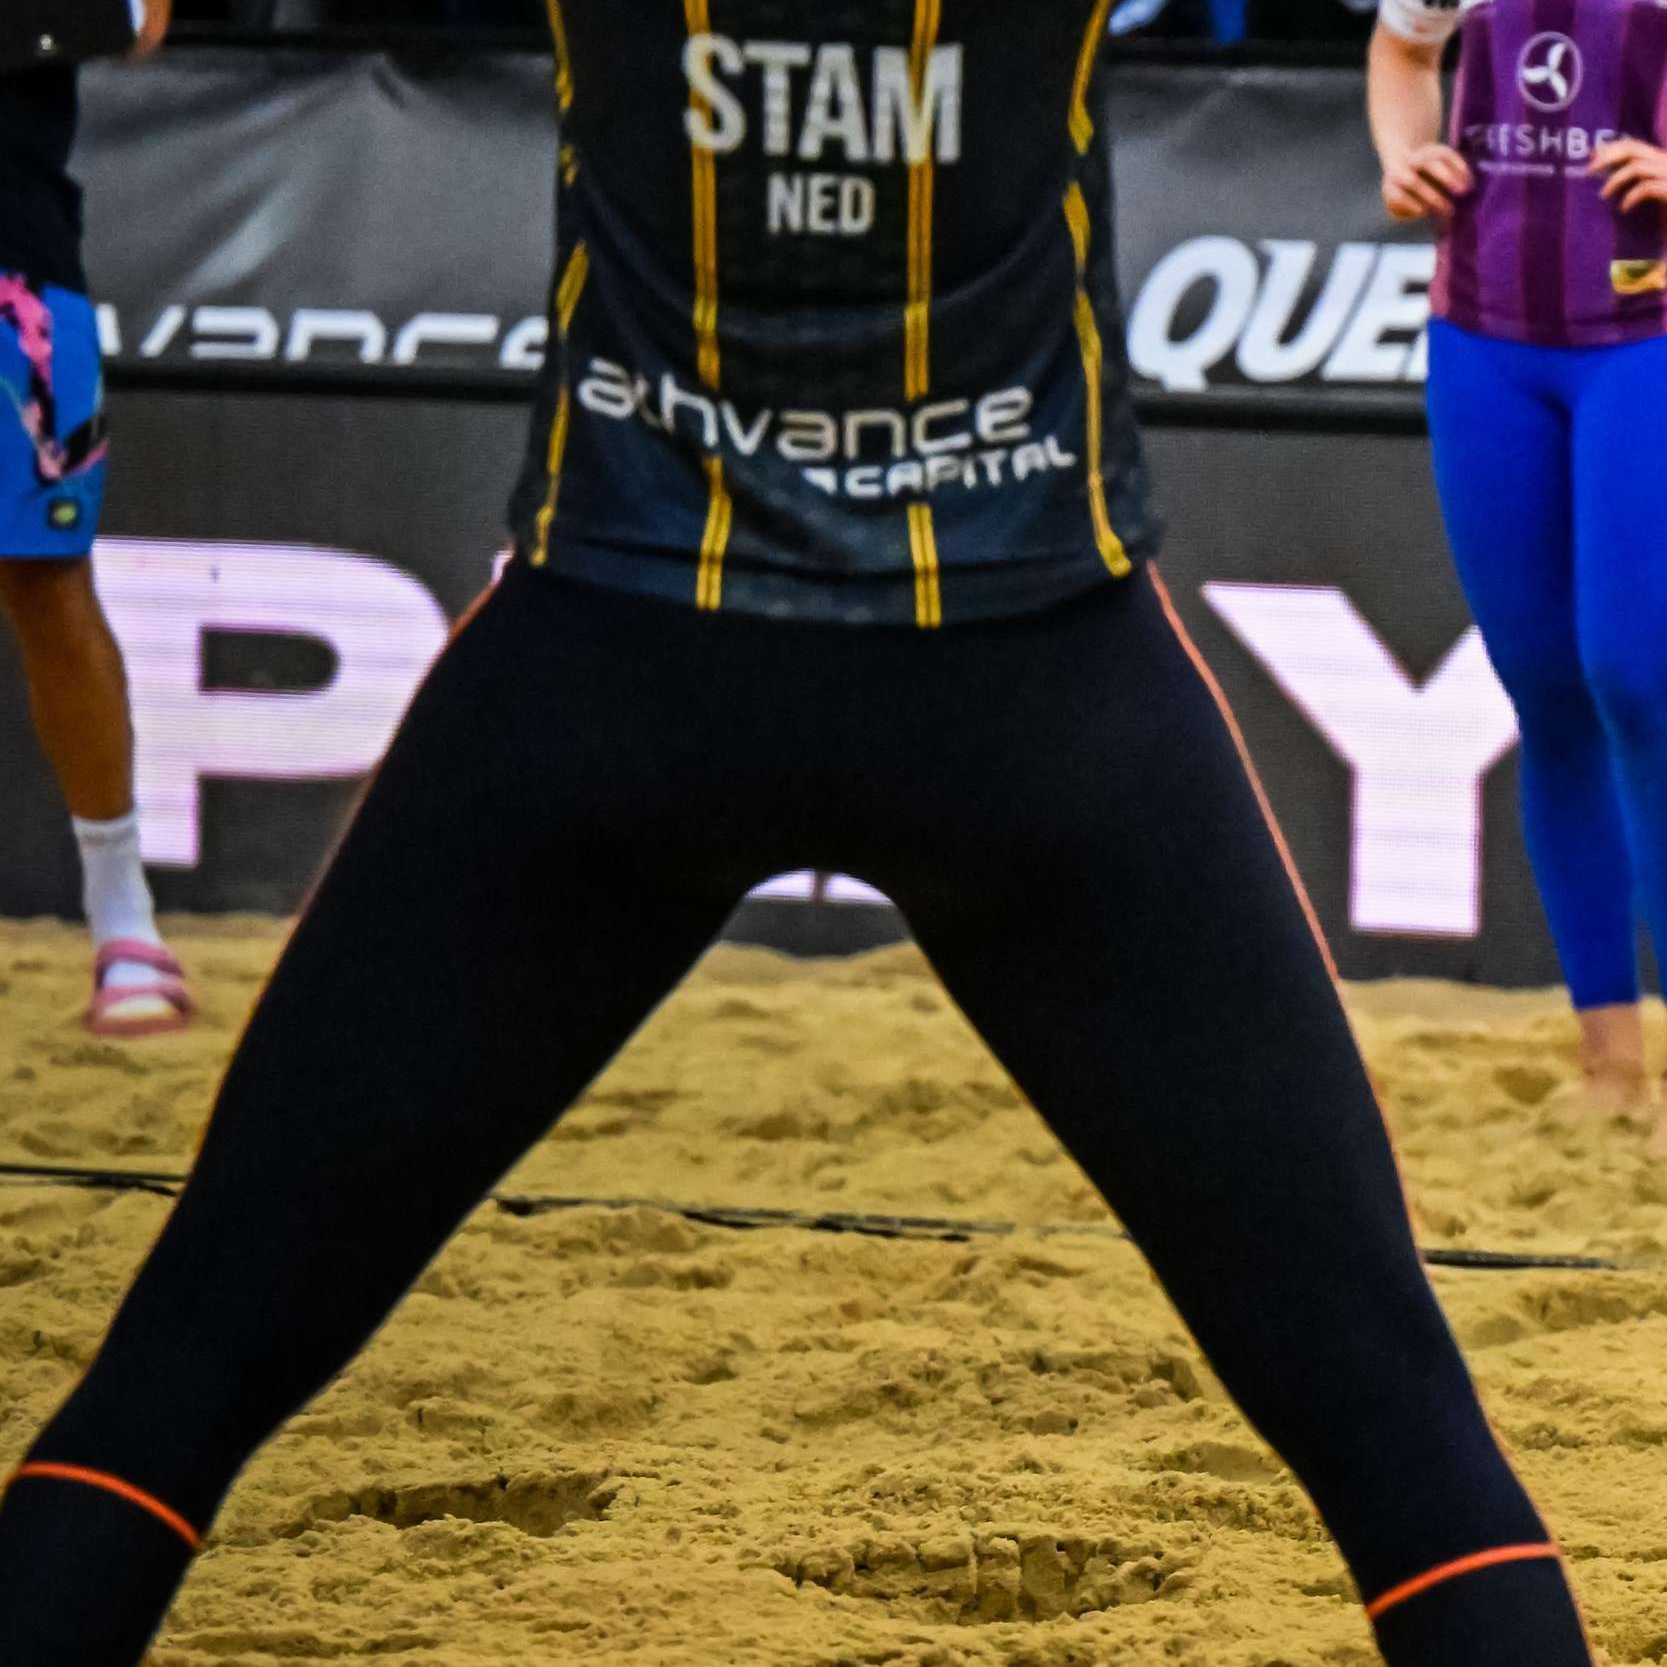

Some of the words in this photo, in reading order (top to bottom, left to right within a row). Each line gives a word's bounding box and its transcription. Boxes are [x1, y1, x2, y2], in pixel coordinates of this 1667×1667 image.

[682, 33, 965, 165] STAM
[767, 172, 876, 235] NED
[844, 437, 1077, 499] CAPITAL
